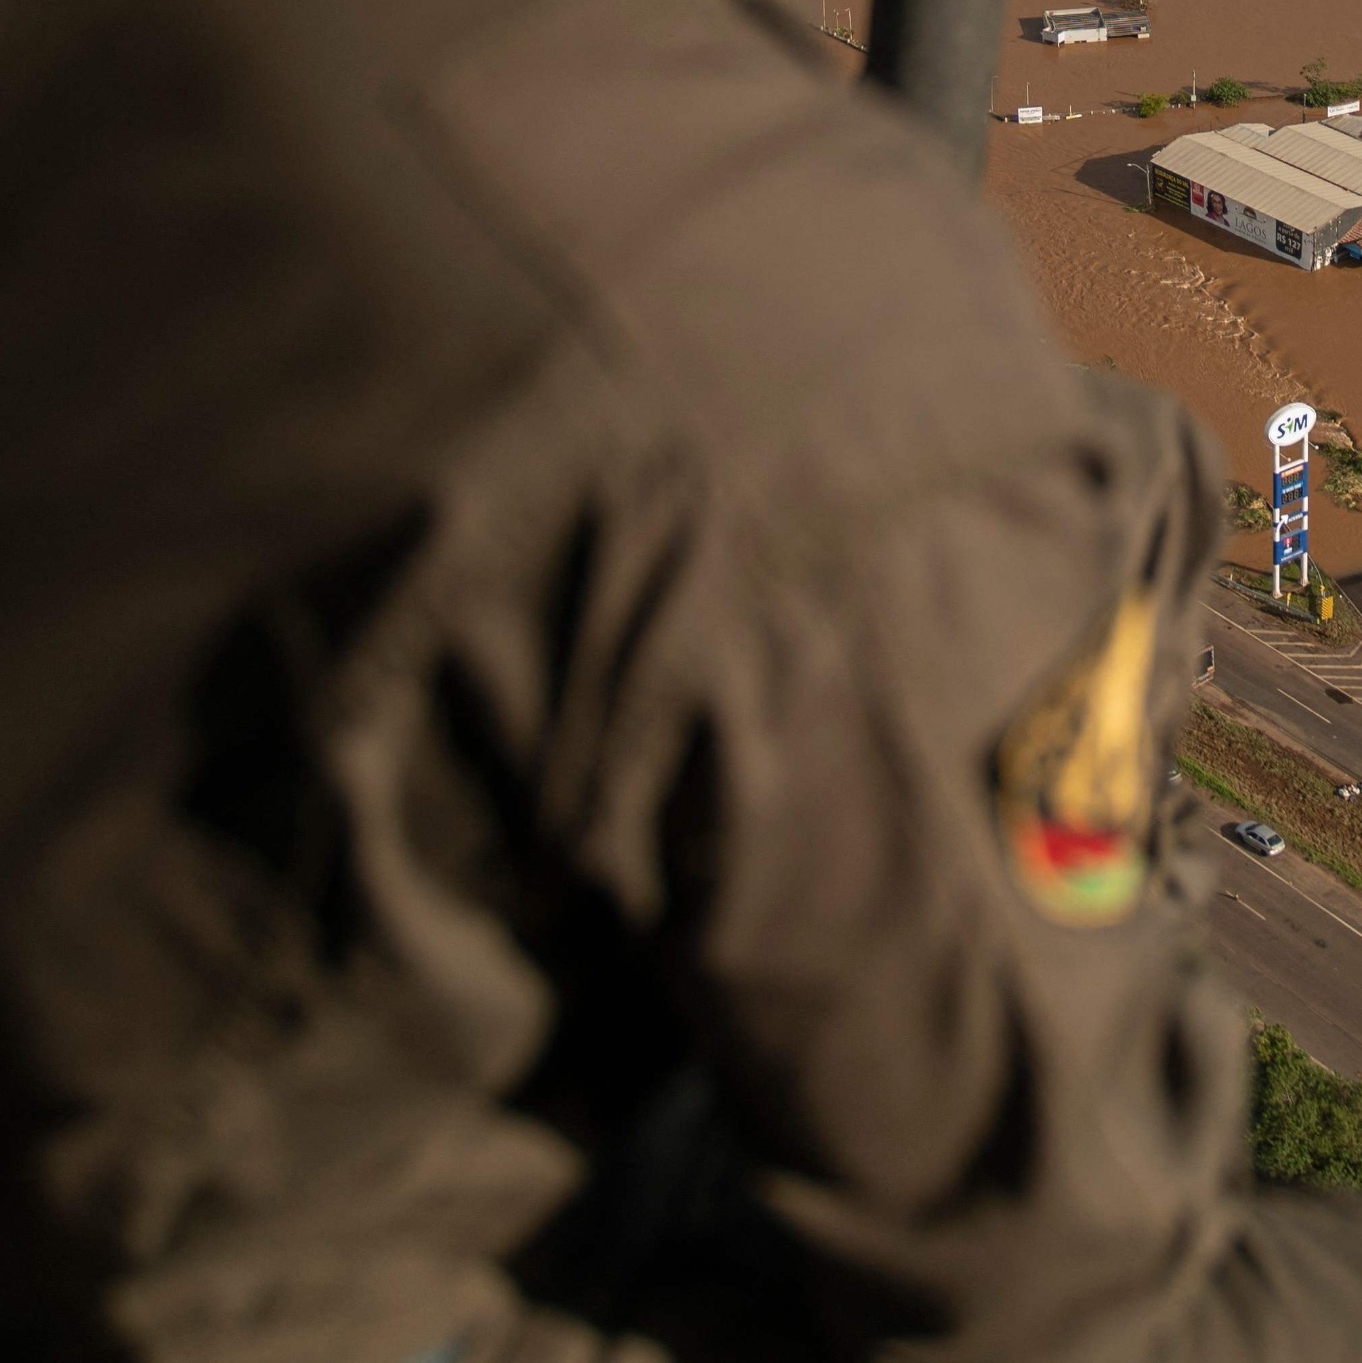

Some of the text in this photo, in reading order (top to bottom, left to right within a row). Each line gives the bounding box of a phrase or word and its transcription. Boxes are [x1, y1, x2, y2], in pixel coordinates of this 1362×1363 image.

[1235, 217, 1267, 239] LAGOS
[1277, 232, 1286, 244] R$
[1288, 238, 1301, 251] 127
